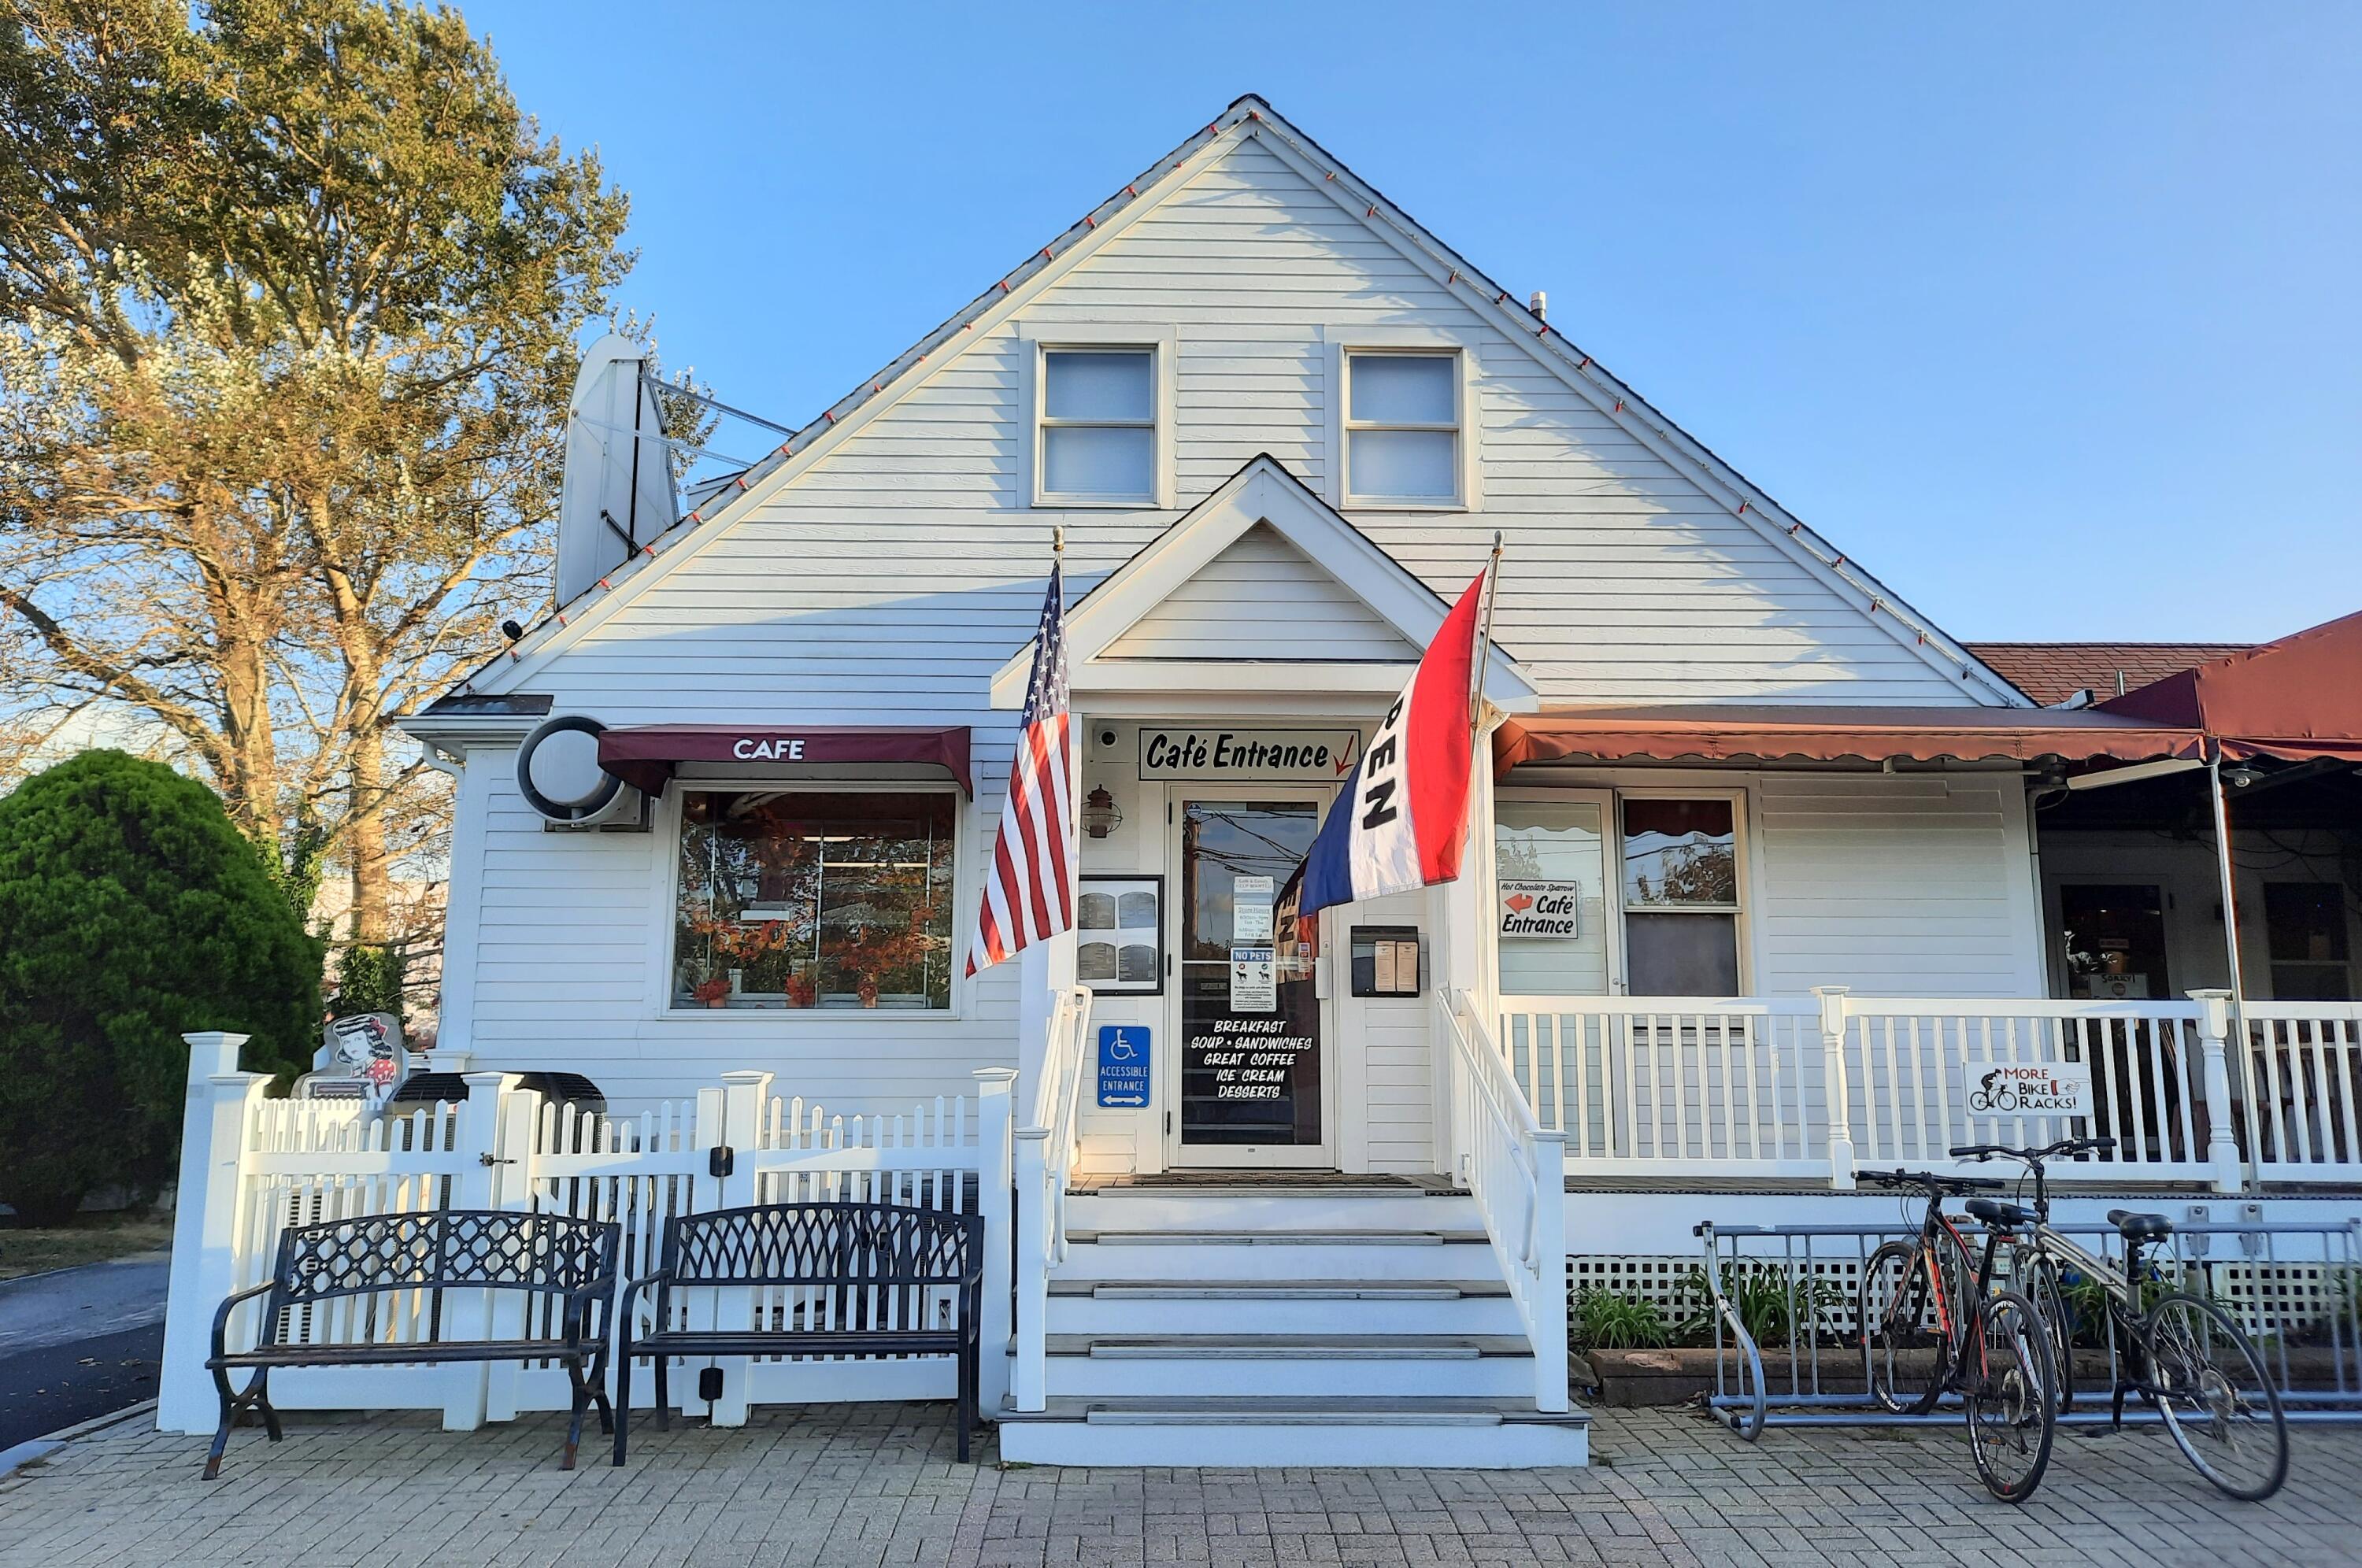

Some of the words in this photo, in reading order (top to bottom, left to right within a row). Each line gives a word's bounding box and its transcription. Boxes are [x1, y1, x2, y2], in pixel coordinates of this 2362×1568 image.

[733, 738, 805, 760] CAFE
[1146, 733, 1208, 769] Café
[1213, 734, 1329, 769] Entrance
[1363, 696, 1405, 830] PEN
[1501, 882, 1512, 891] Hot
[1514, 882, 1546, 892] Chocolate
[1546, 883, 1575, 893] Sparrow
[1536, 895, 1574, 915] Café
[1501, 913, 1574, 934] Entrance
[1235, 952, 1248, 960] NO
[1249, 952, 1272, 960] PETS
[1213, 1020, 1287, 1034] BREAKFAST
[1190, 1036, 1224, 1049] SOUP
[1235, 1036, 1312, 1050] SANDWICHES
[1204, 1052, 1246, 1066] GREAT
[1250, 1052, 1297, 1066] COFFEE
[1100, 1066, 1149, 1078] ACCESSIBLE
[1216, 1068, 1237, 1082] ICE
[1242, 1069, 1285, 1083] CREAM
[2004, 1067, 2049, 1080] MORE
[1102, 1080, 1145, 1092] ENTRANCE
[1217, 1085, 1281, 1099] DESSERTS
[2019, 1082, 2049, 1096] BIKE
[2020, 1096, 2077, 1110] RACKS!
